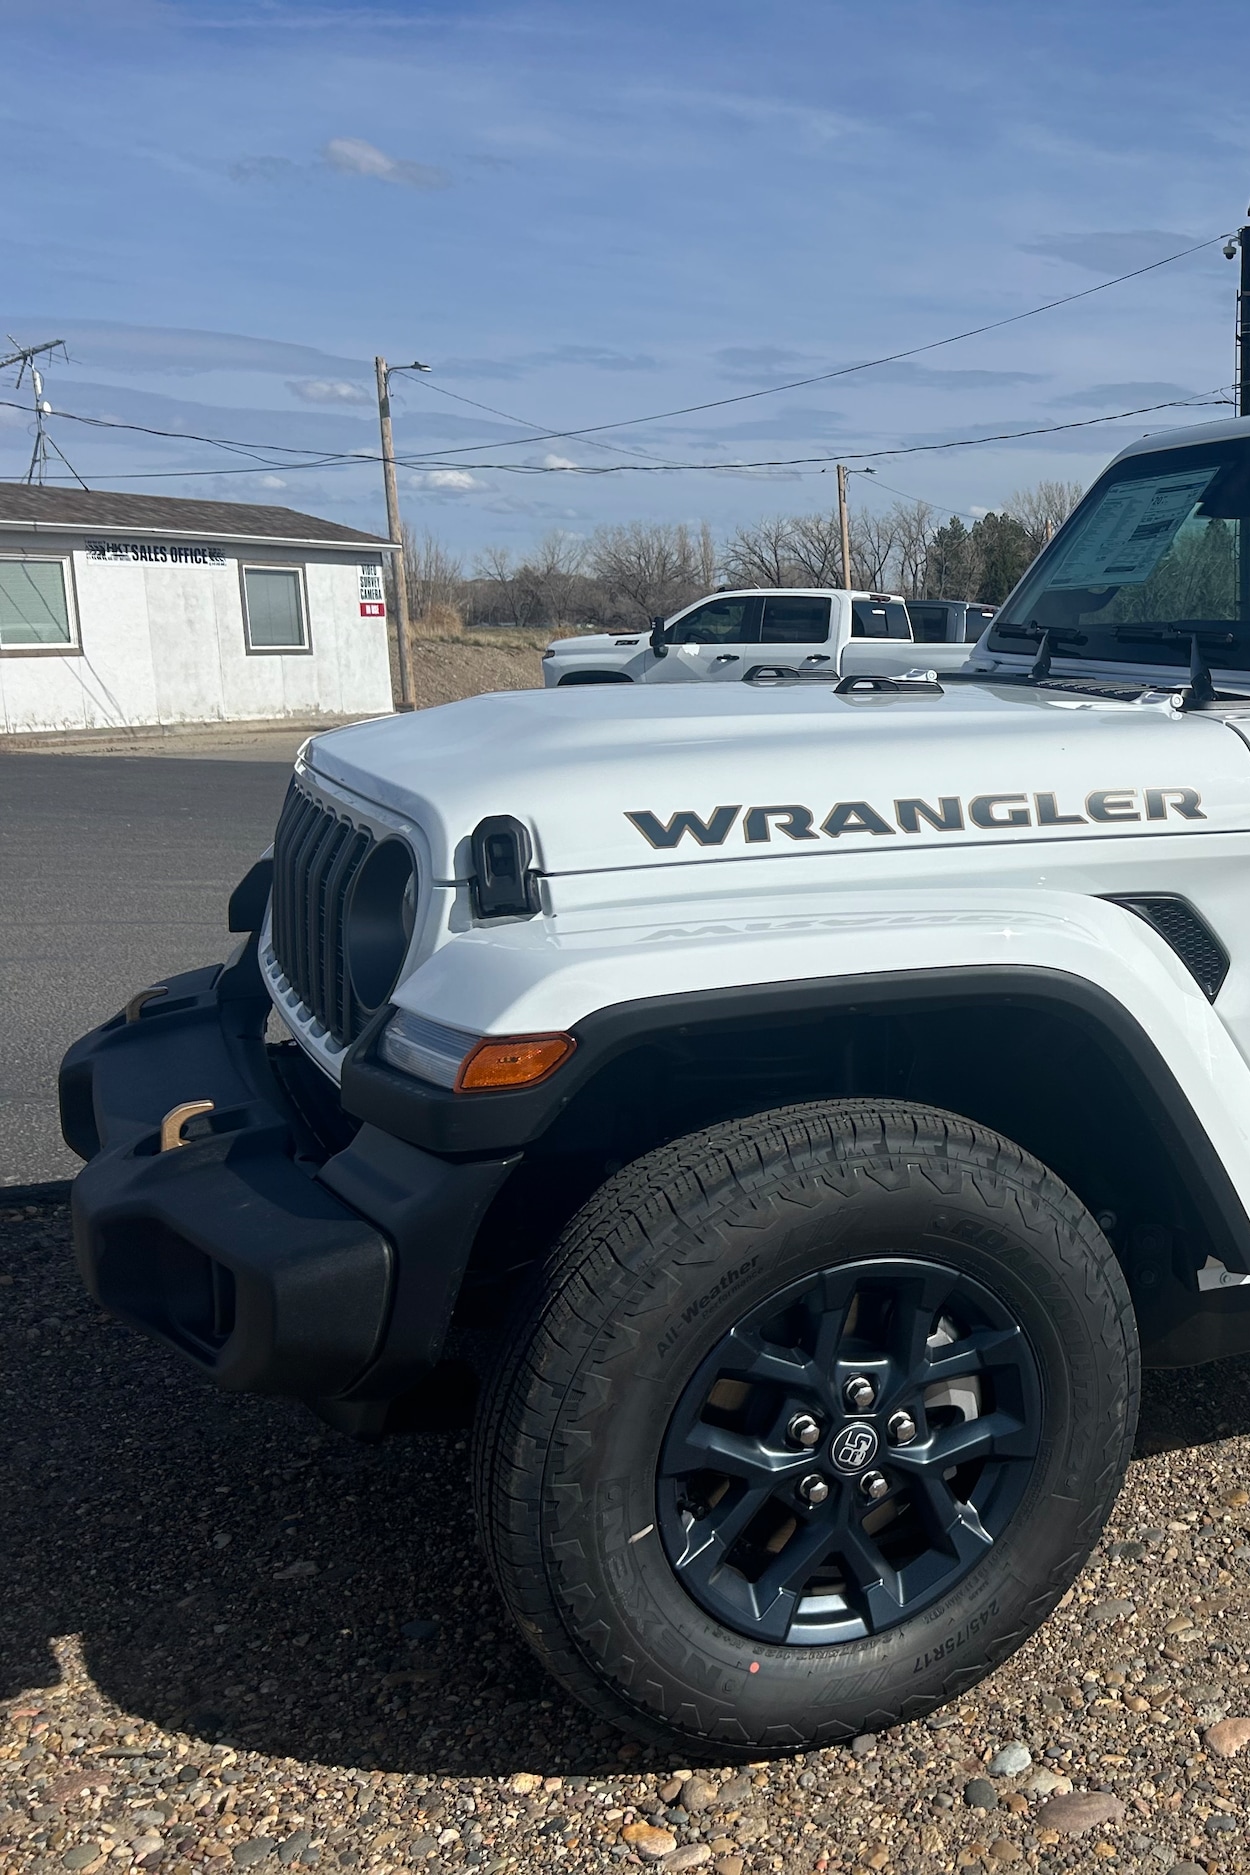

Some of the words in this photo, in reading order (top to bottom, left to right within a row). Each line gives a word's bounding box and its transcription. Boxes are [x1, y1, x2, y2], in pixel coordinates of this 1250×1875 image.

[131, 544, 167, 562] SALES
[170, 546, 208, 564] OFFICE
[361, 564, 377, 576] VIDEO
[360, 588, 383, 600] CAMERA
[624, 787, 1208, 850] WRANGLER
[655, 1254, 760, 1359] All-Weather
[702, 1267, 764, 1320] Performance
[838, 1431, 873, 1466] 85
[913, 1600, 1000, 1674] 245/75R17
